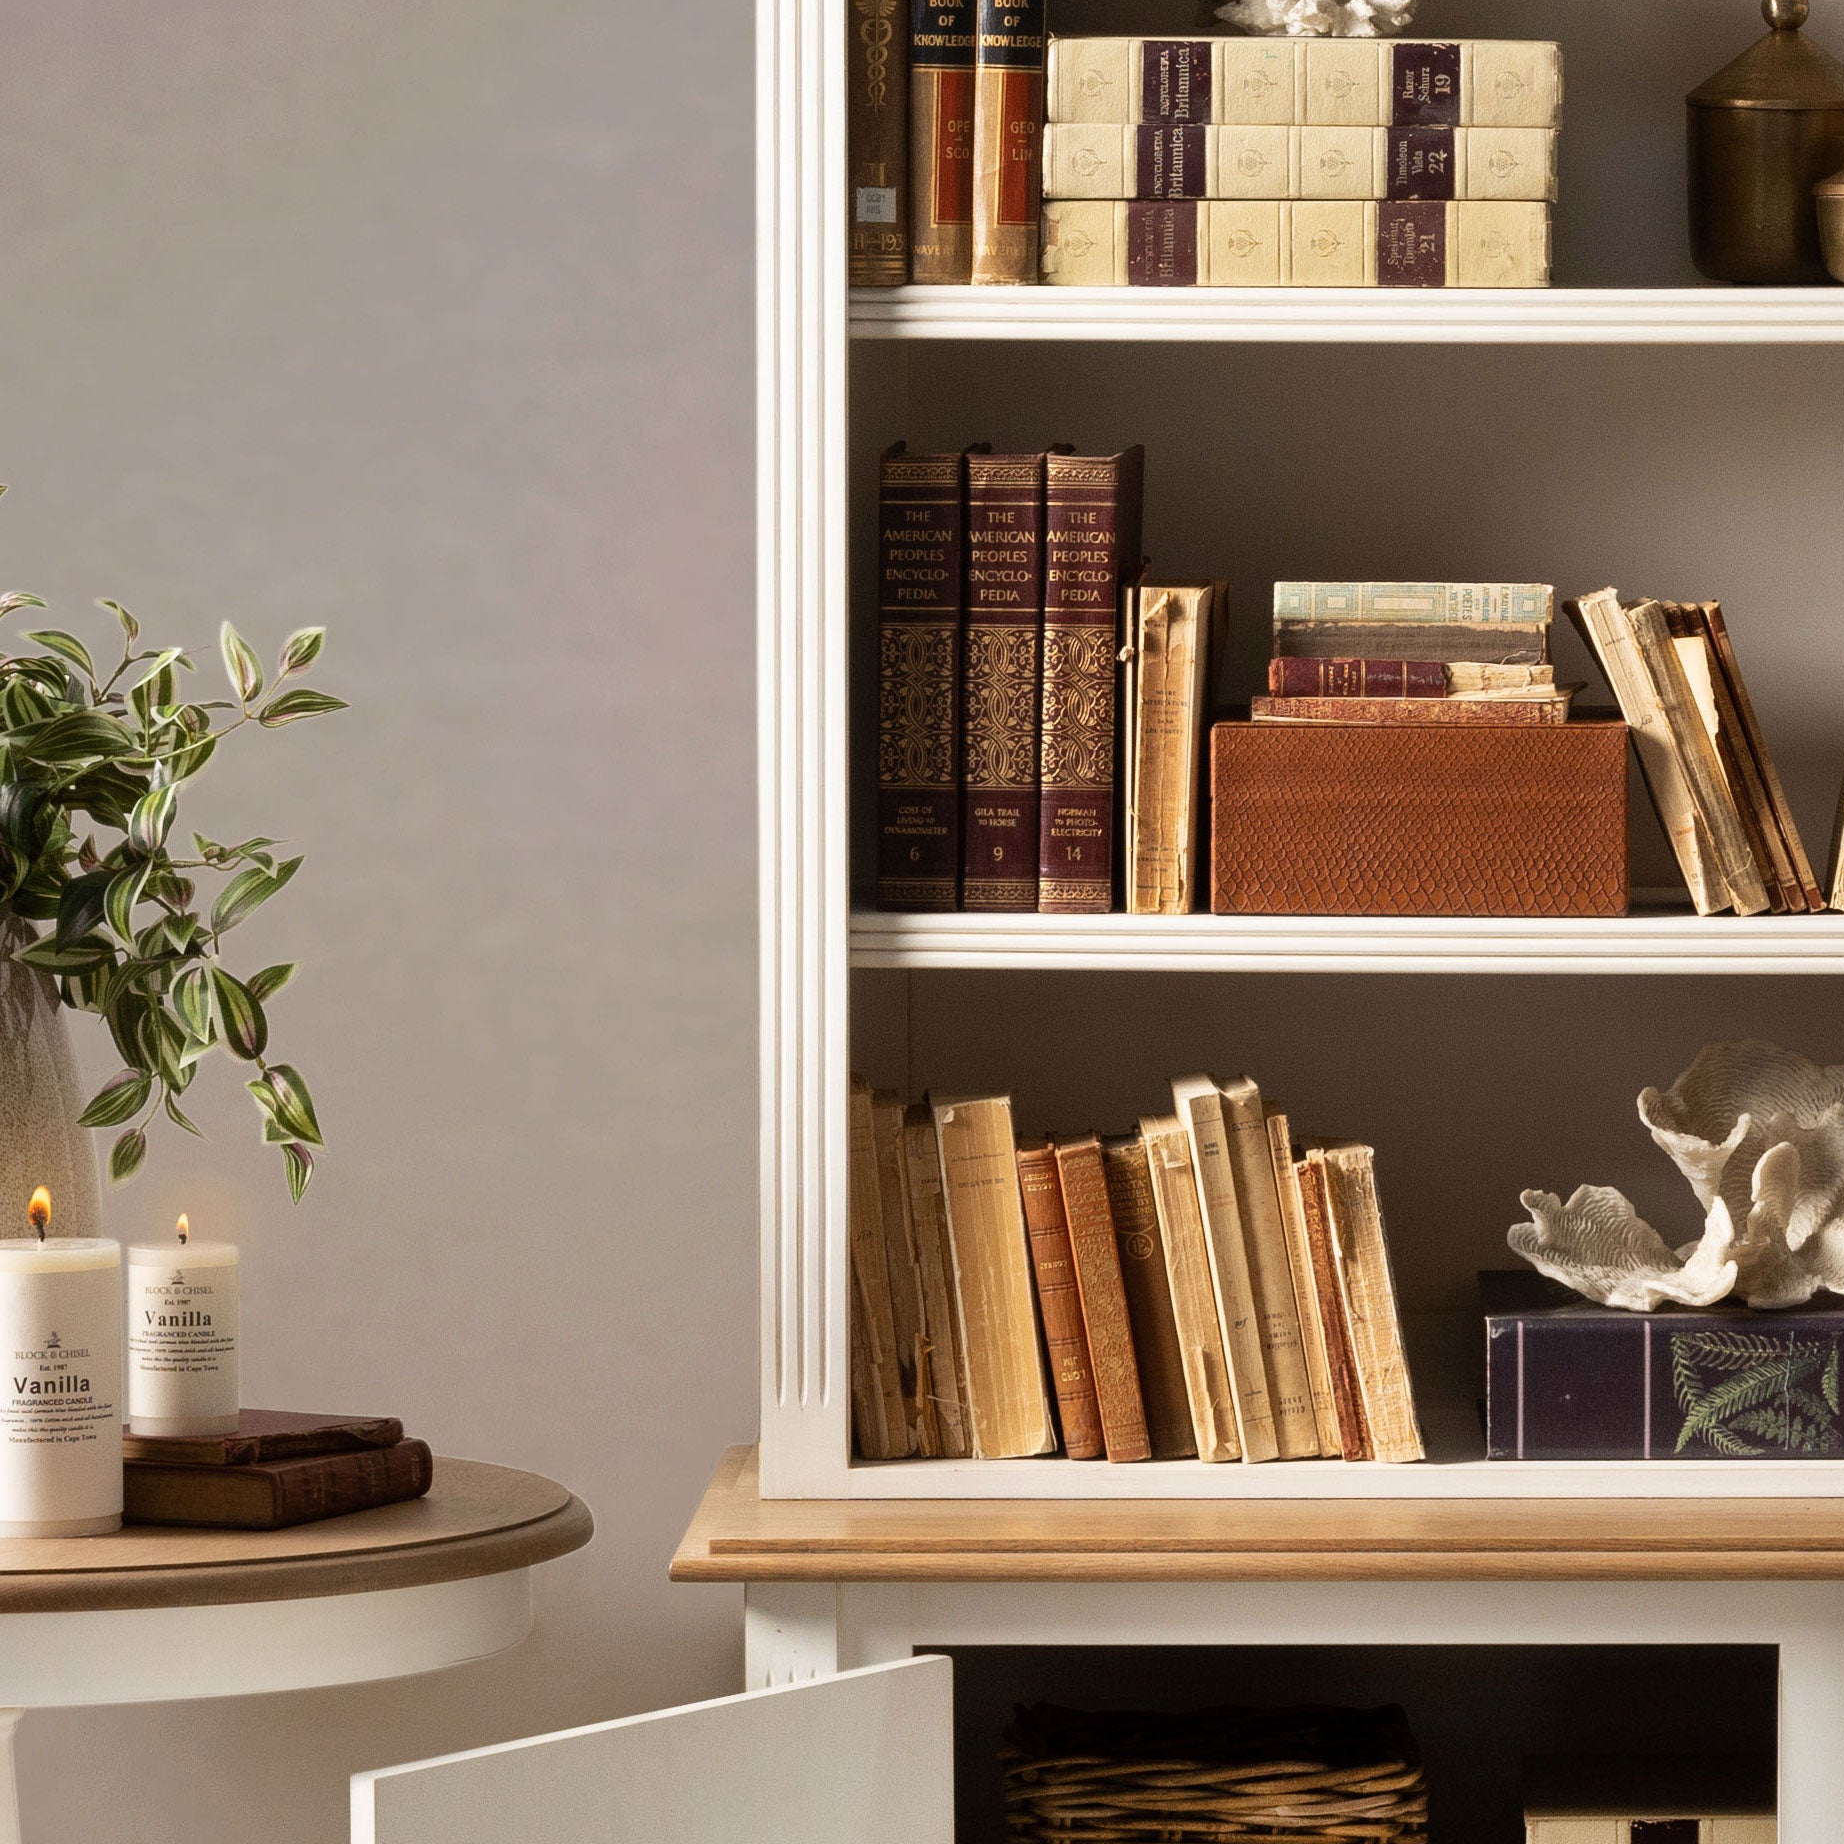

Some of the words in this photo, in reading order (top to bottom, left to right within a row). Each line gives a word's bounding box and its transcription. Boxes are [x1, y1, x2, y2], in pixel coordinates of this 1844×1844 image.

[938, 16, 956, 27] OF
[1004, 16, 1020, 27] OF
[914, 34, 977, 47] KNOWLEDGE
[981, 34, 1043, 48] KNOWLEDGE
[1174, 47, 1190, 119] Britannica
[1403, 69, 1414, 99] Razor
[1418, 67, 1431, 102] Schurz
[1435, 74, 1451, 95] 19
[948, 120, 970, 133] OPE
[1010, 122, 1034, 134] GEO
[945, 147, 970, 159] SCO
[1012, 148, 1033, 161] LIN
[1168, 127, 1184, 198] Britannica
[1396, 140, 1408, 186] Timoleon
[1412, 150, 1424, 175] Vieta
[1159, 208, 1174, 278] Britannica
[1420, 233, 1435, 254] 21
[904, 511, 930, 522] THE
[987, 512, 1015, 523] THE
[1070, 512, 1097, 524] THE
[883, 529, 952, 542] AMERICAN
[1046, 531, 1115, 543] AMERICAN
[890, 549, 944, 561] PEOPLES
[972, 551, 1028, 563] PEOPLES
[1053, 551, 1109, 563] PEOPLES
[898, 588, 937, 599] PEDIA
[980, 589, 1020, 601] PEDIA
[1061, 589, 1102, 601] PEDIA
[975, 808, 994, 817] GILA
[997, 808, 1020, 817] TRAIL
[1057, 808, 1096, 817] NORMAN
[989, 818, 1017, 827] HORSE
[1051, 828, 1102, 837] ELECTRICITY
[910, 846, 920, 861] 6
[993, 847, 1003, 862] 9
[1066, 847, 1082, 861] 14
[145, 1311, 211, 1326] Vanilla
[15, 1350, 48, 1360] BLOCK
[59, 1349, 90, 1358] CHISEL
[1060, 1369, 1086, 1382] LORD
[13, 1375, 90, 1394] Vanilla
